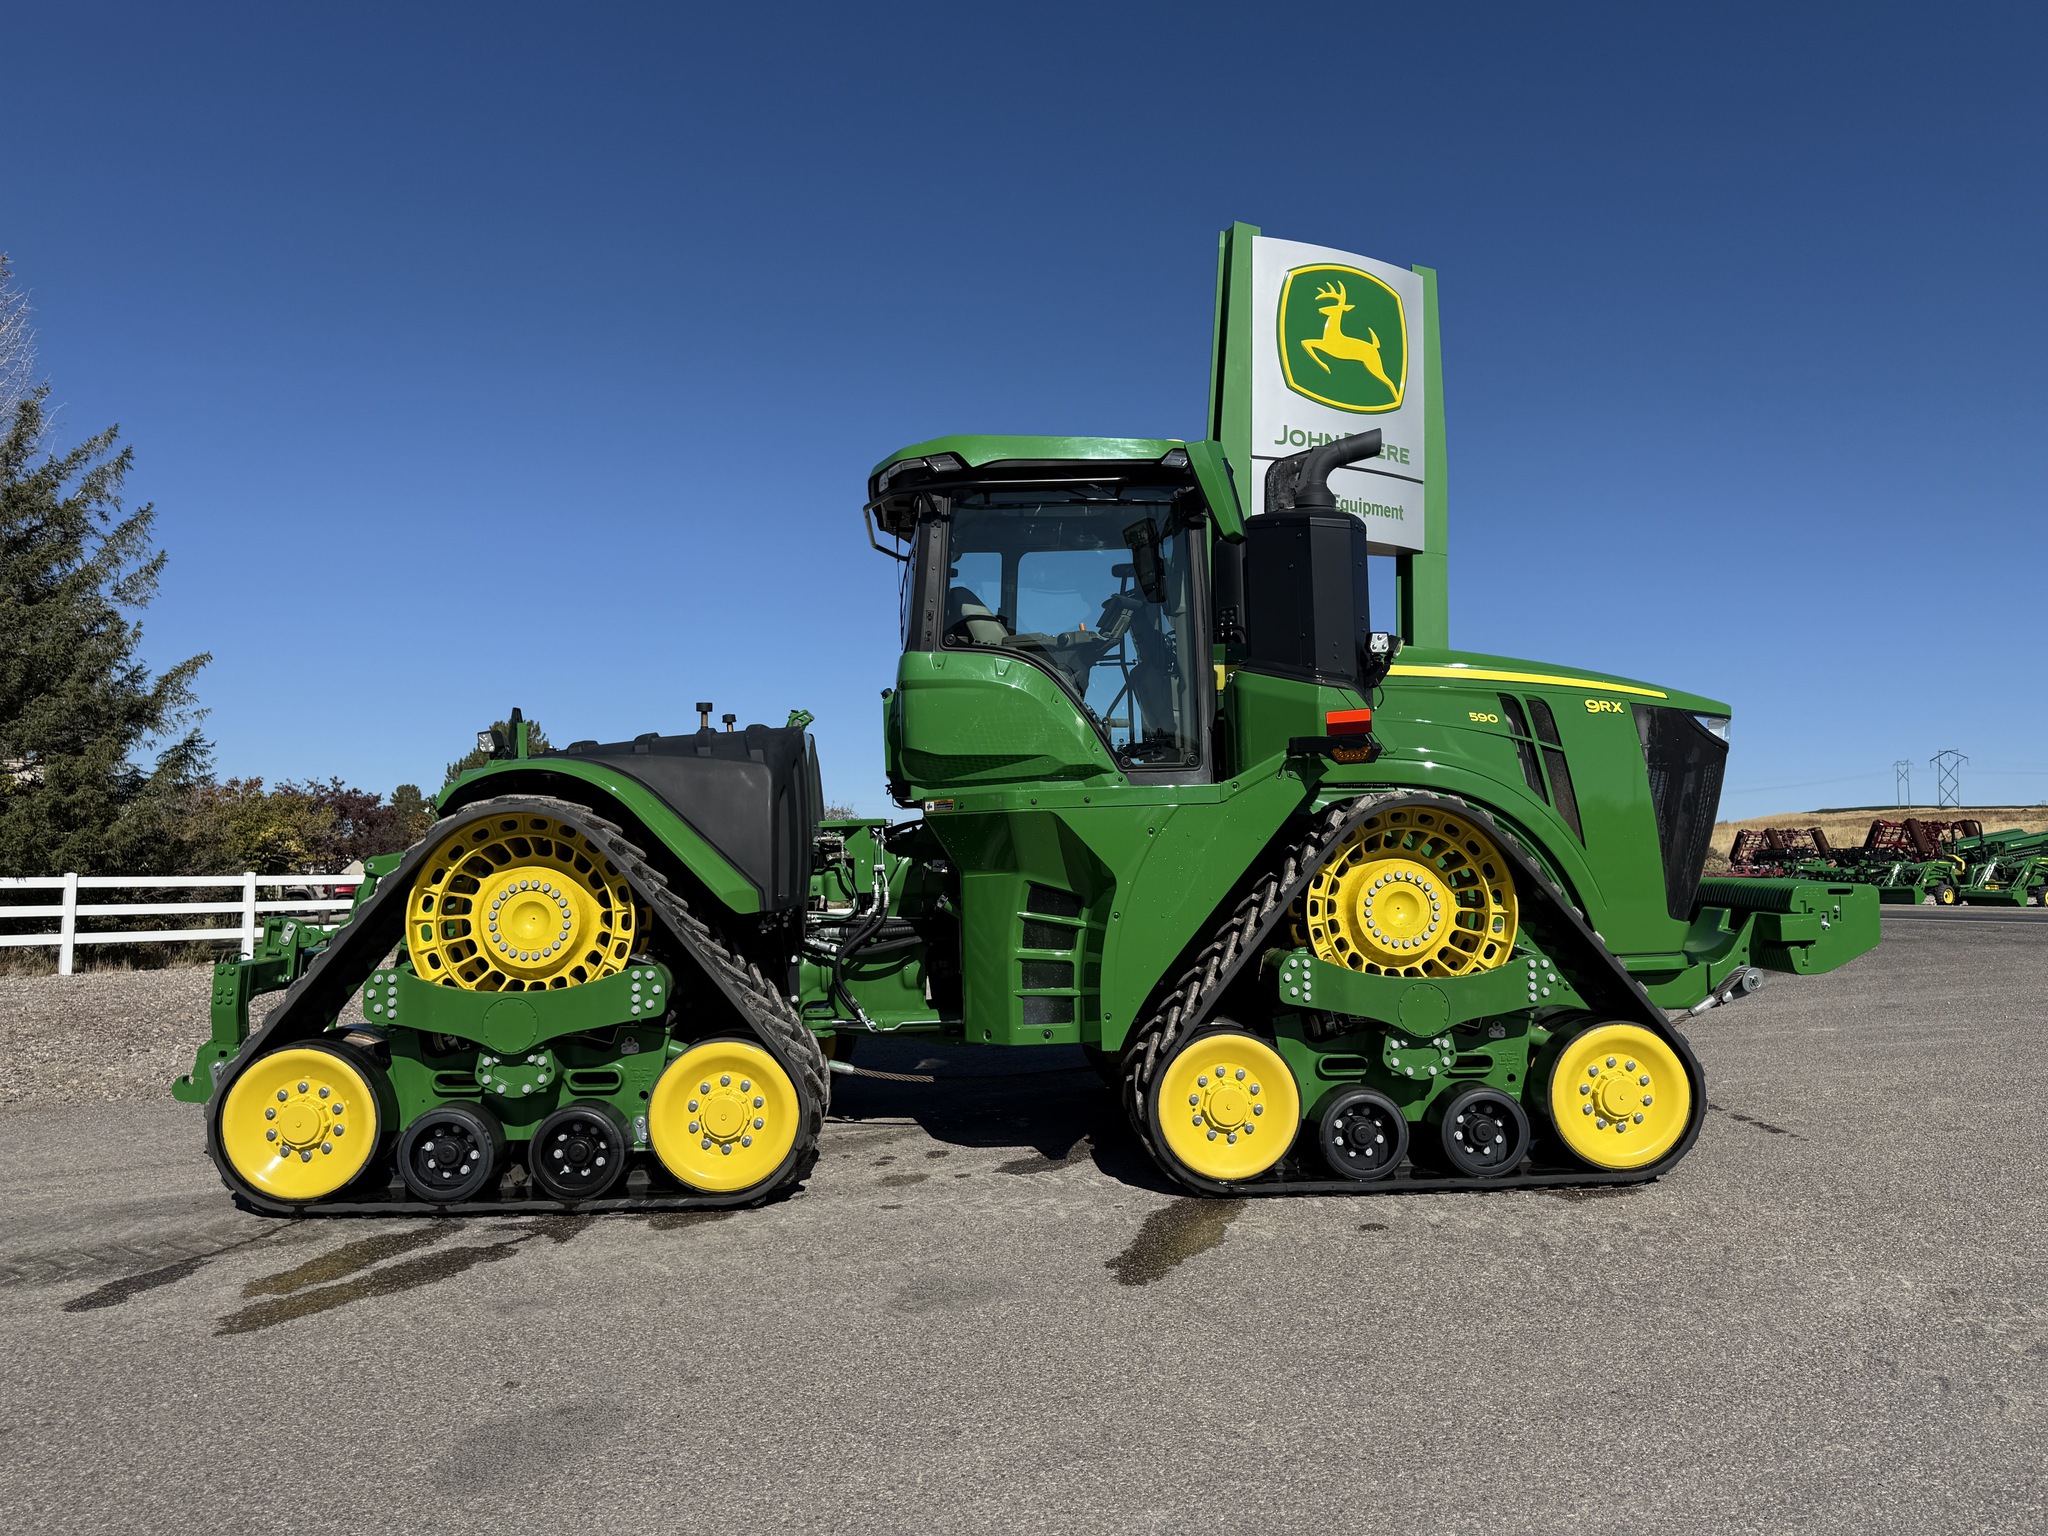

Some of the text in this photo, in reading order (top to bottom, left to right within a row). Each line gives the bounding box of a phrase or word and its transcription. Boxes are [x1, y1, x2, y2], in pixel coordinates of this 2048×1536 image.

[1344, 432, 1410, 465] ERE
[1584, 699, 1625, 714] 9RX
[1468, 711, 1499, 724] 590
